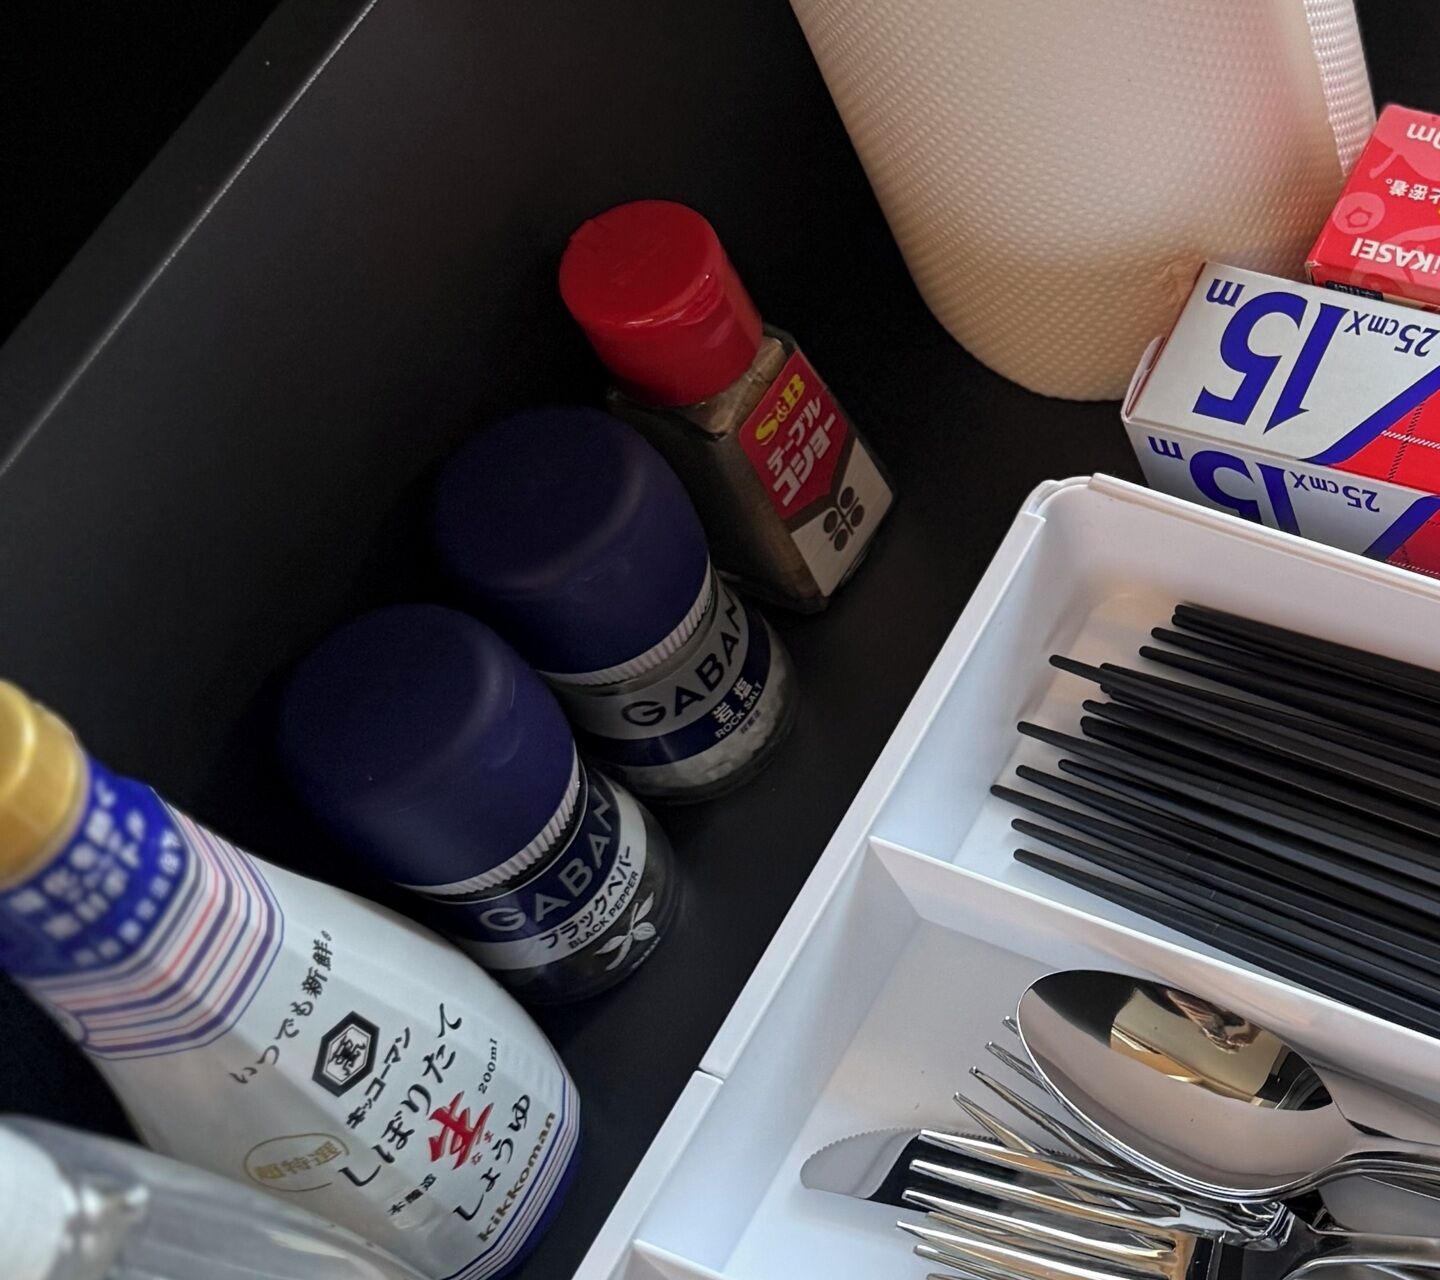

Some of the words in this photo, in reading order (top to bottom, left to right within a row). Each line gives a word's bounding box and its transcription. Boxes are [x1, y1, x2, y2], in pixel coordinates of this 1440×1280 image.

[754, 373, 806, 447] S&B
[766, 397, 822, 478] テーブル
[772, 412, 837, 508] コショー
[620, 598, 742, 728] GABAN
[714, 710, 746, 739] ROCK
[742, 680, 764, 709] SALT
[480, 784, 613, 932] GABAN
[568, 919, 610, 950] BLACK
[608, 871, 640, 918] PEPPER
[338, 1002, 463, 1187] しぼりたて
[346, 1026, 411, 1130] キッコーマン
[426, 1090, 496, 1171] 生
[452, 1093, 531, 1222] しょうゆ
[476, 1111, 557, 1243] kikkoman
